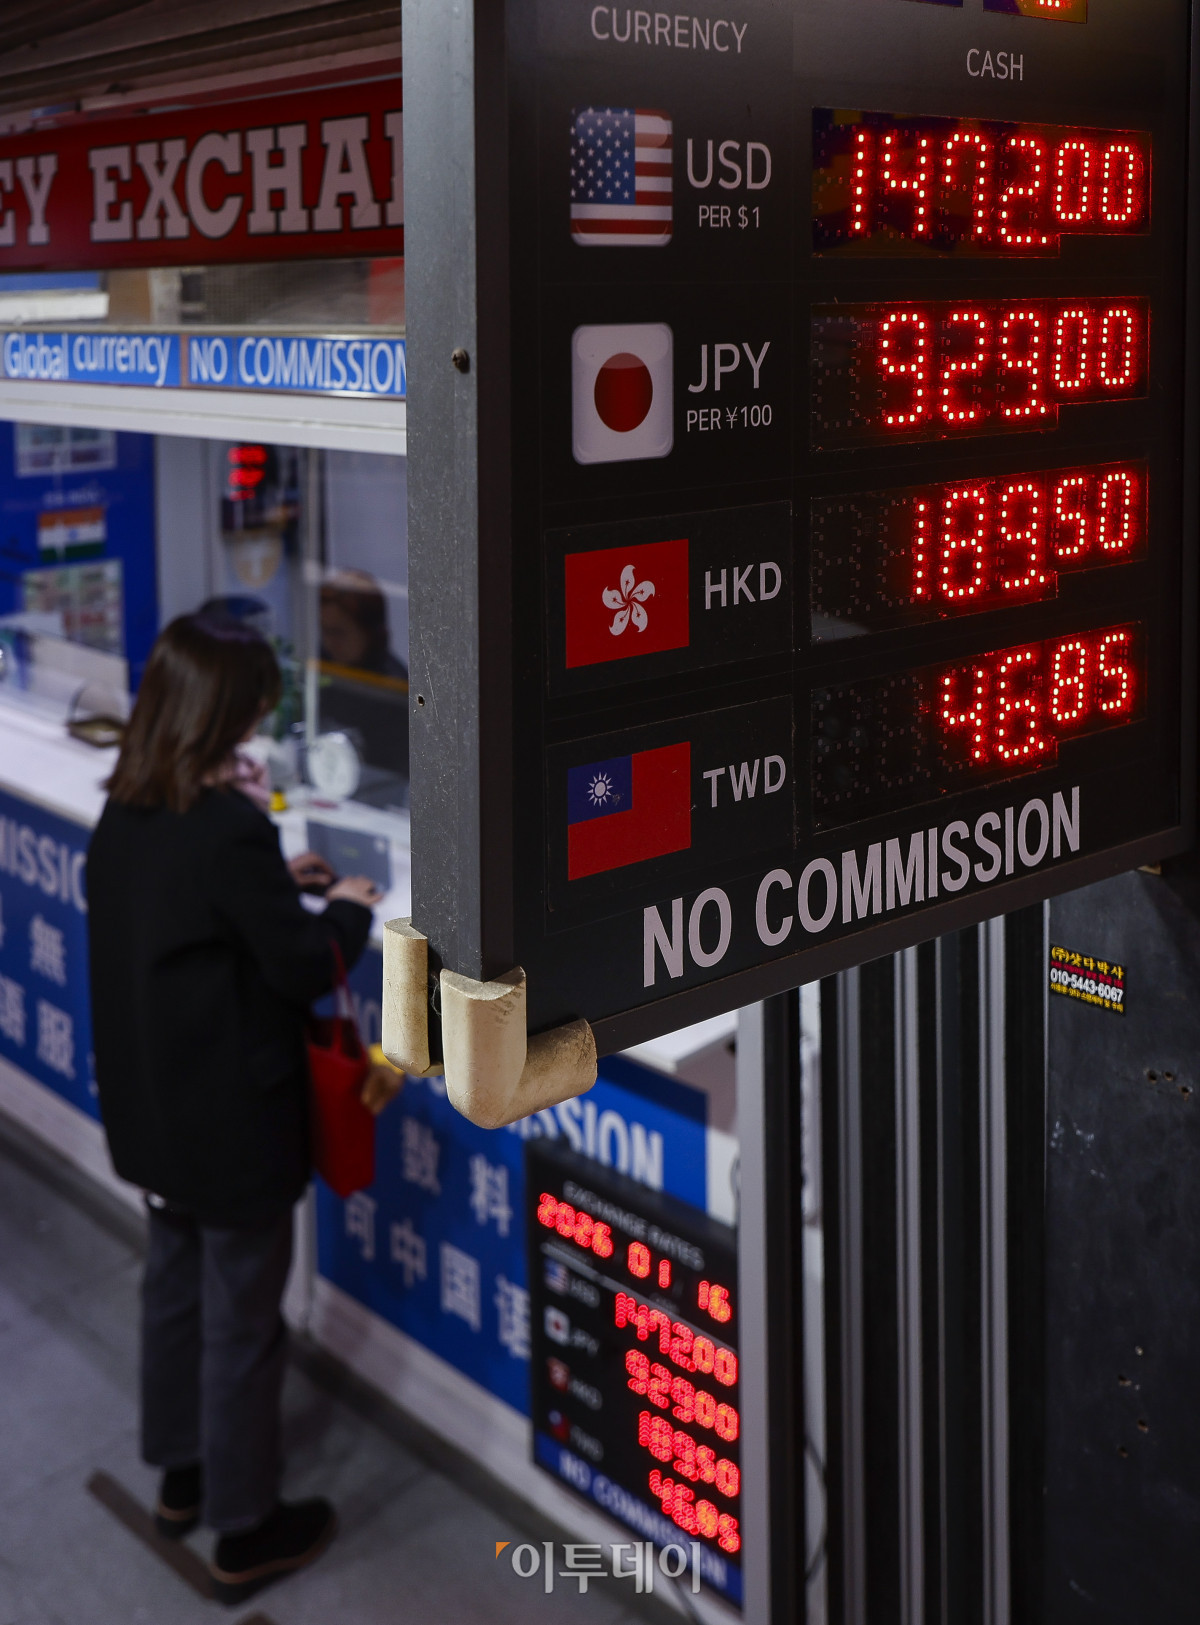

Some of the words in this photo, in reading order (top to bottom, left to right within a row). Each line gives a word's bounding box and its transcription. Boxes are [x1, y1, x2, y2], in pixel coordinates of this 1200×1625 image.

[590, 5, 748, 54] CURRENCY
[966, 48, 1024, 81] CASH
[687, 138, 772, 190] USD
[698, 205, 731, 228] PER
[4, 333, 68, 379] Global
[73, 335, 171, 387] currency
[190, 337, 228, 382] NO
[687, 341, 771, 393] JPY
[687, 408, 721, 432] PER
[725, 404, 772, 431] ¥100
[704, 561, 783, 610] HKD
[703, 754, 787, 808] TWD
[643, 887, 732, 988] NO
[755, 786, 1080, 946] COMMISSION
[1050, 967, 1123, 1003] 010-5443-6067
